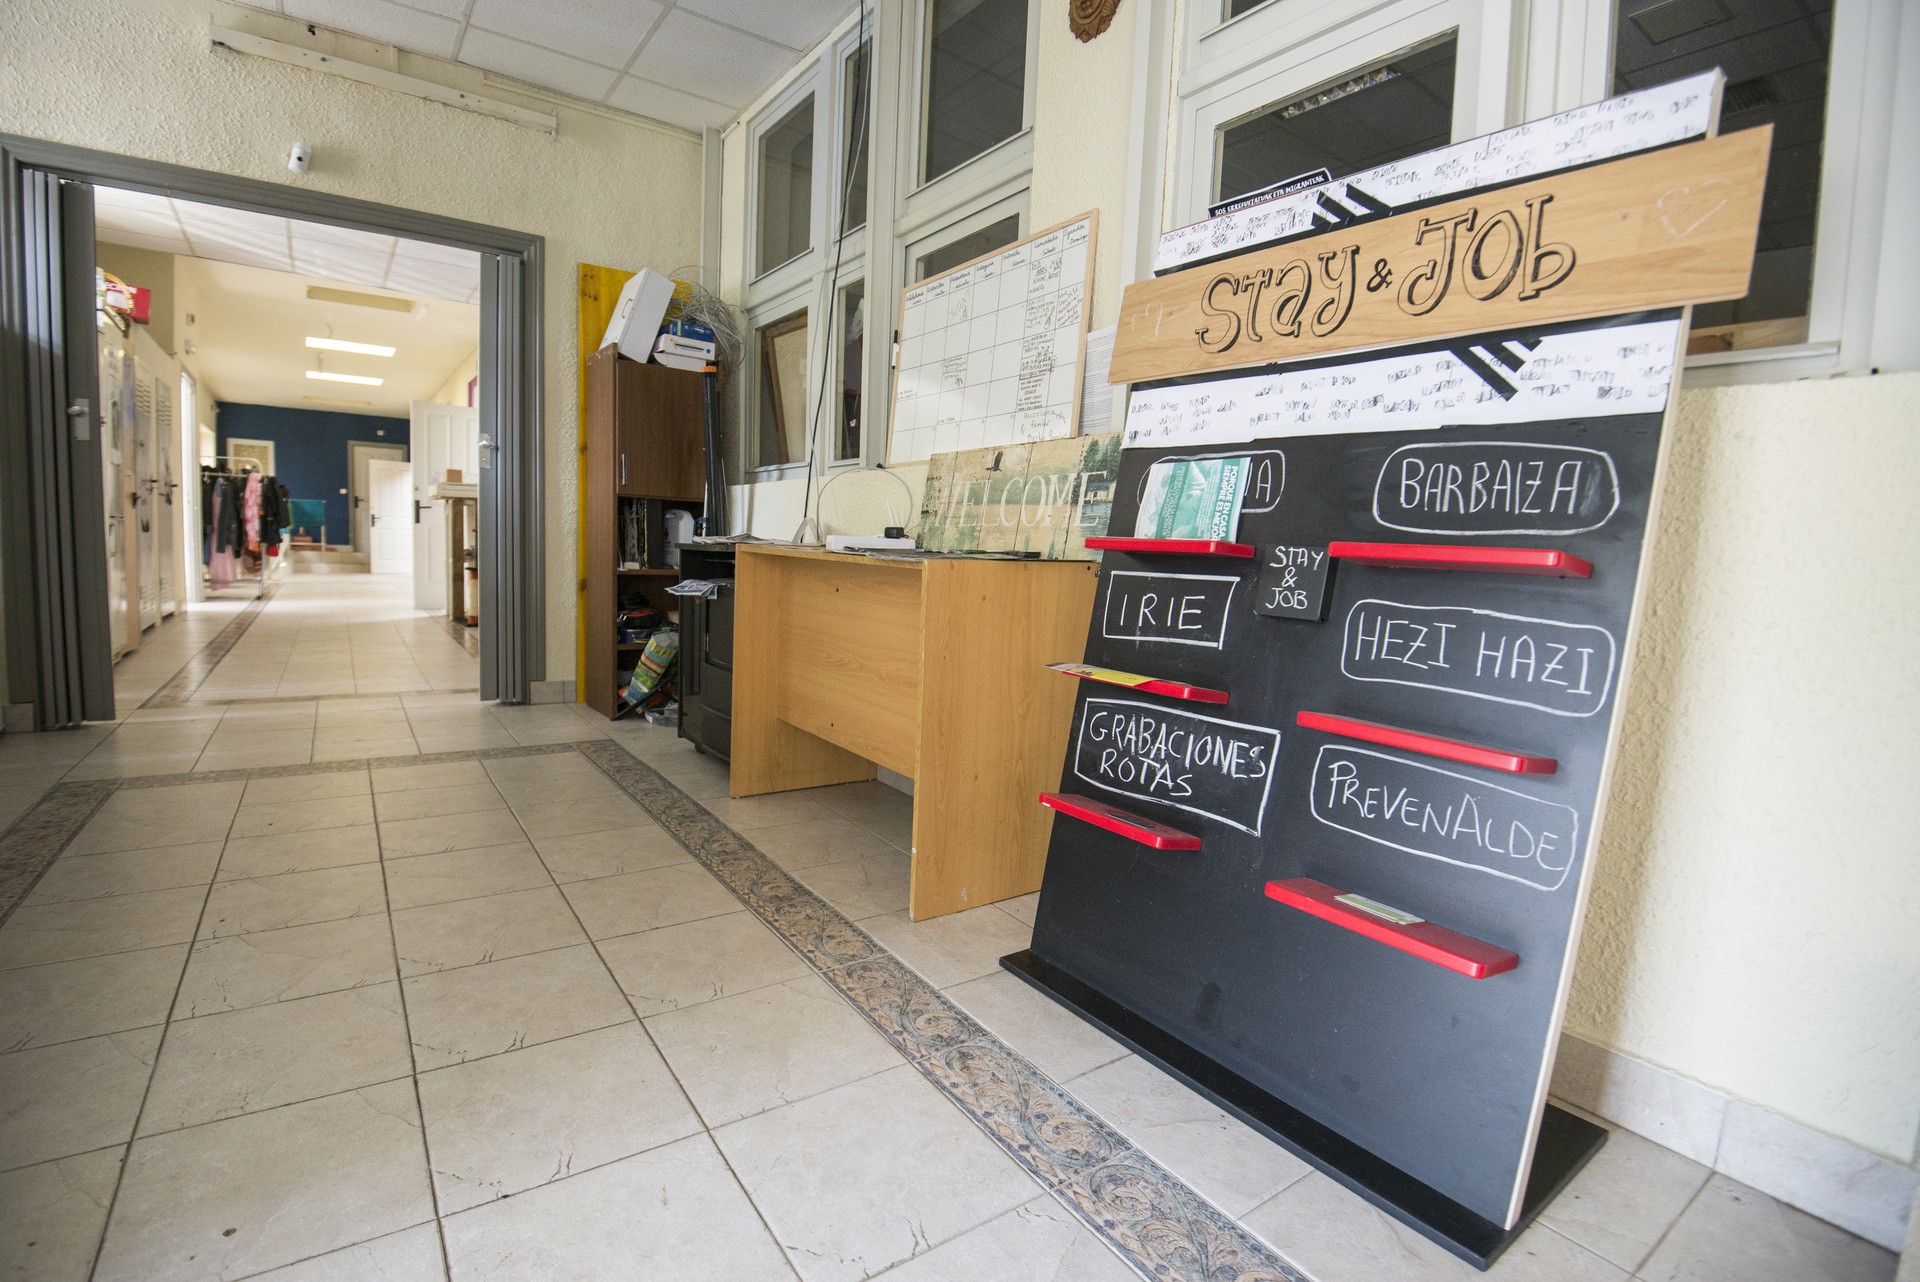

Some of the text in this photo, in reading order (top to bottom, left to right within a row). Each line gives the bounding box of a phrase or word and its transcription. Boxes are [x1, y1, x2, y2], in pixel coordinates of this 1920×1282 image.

[1366, 258, 1393, 292] &
[929, 471, 1107, 529] WELCOME
[1218, 465, 1231, 501] SIEMPRE
[1226, 466, 1239, 501] PORQUE
[1400, 458, 1584, 515] BARBAIZA
[1216, 501, 1223, 511] ES
[1223, 502, 1232, 514] EN
[1269, 546, 1324, 571] STAY
[1281, 566, 1298, 587] &
[1120, 593, 1206, 630] IRIE
[1265, 588, 1308, 609] JOB
[1355, 611, 1594, 695] HEZI HAZI
[1089, 712, 1266, 779] GRABACIONES
[1100, 748, 1193, 796] ROTAS
[1328, 760, 1565, 871] PREVENALDE
